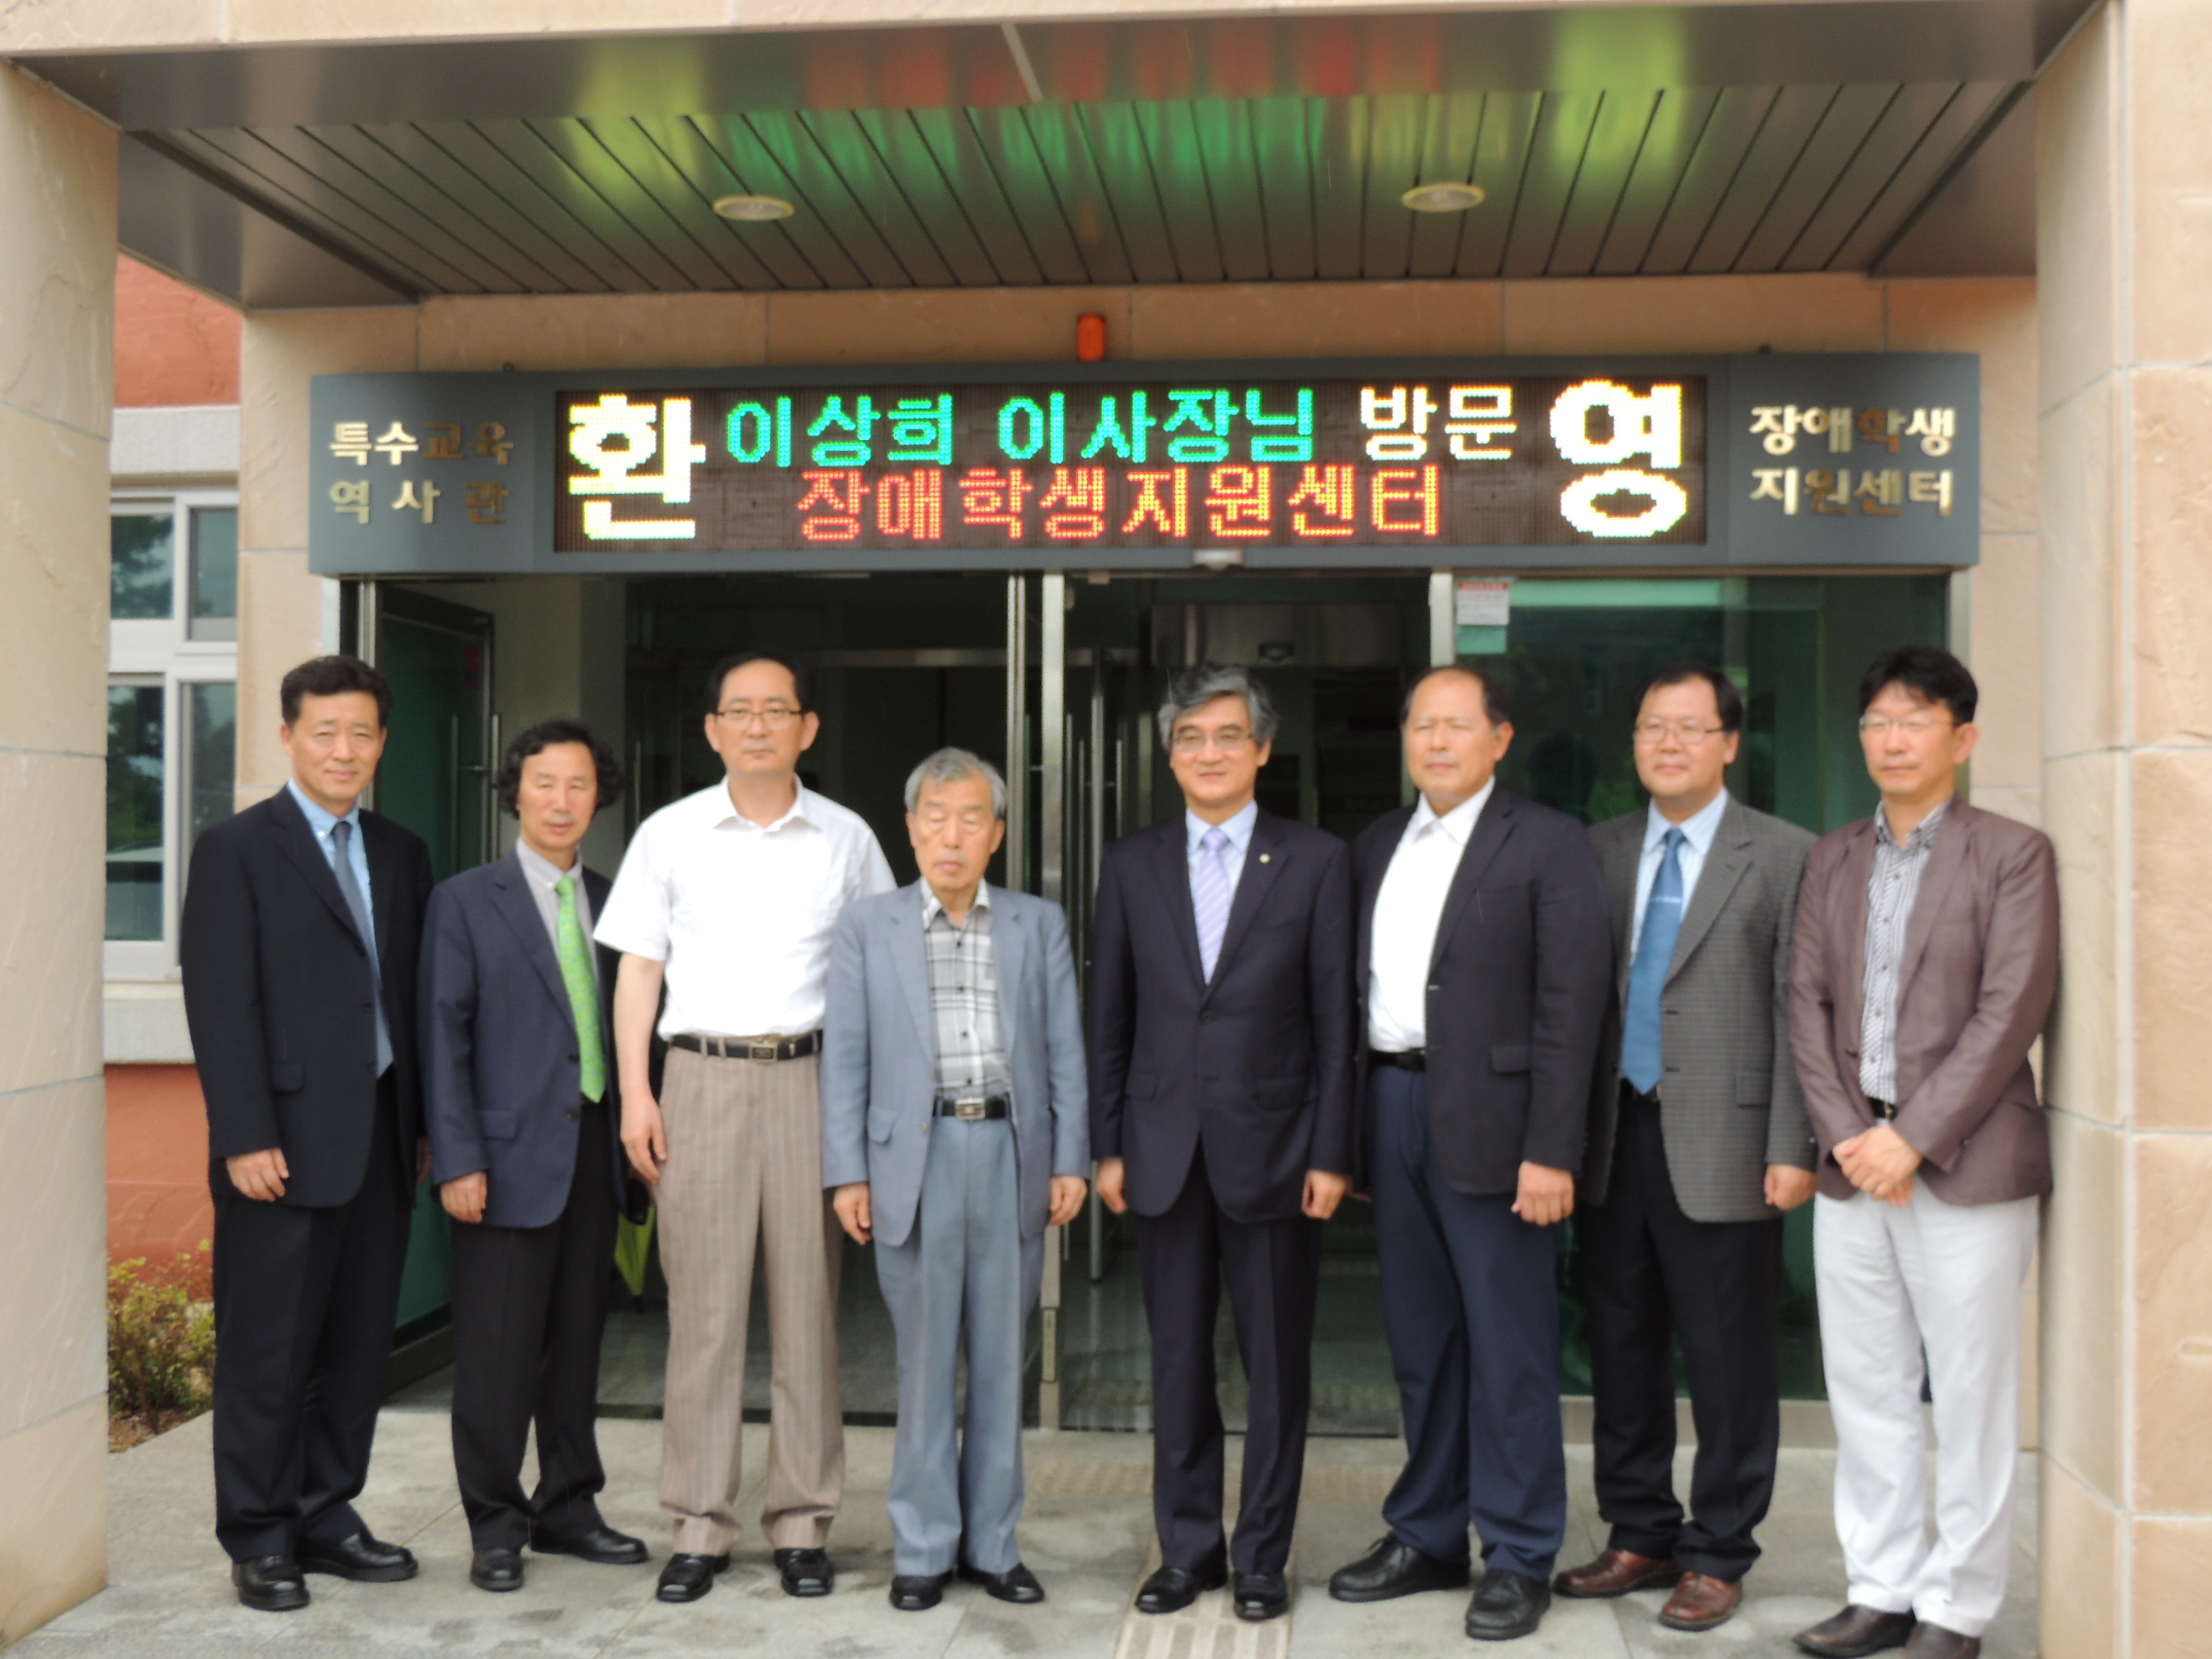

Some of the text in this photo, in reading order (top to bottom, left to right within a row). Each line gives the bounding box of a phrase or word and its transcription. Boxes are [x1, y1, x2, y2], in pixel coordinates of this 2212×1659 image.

[330, 421, 512, 466] 특수교육
[726, 386, 1517, 467] 이상희 이사장님 방문
[1750, 404, 1956, 457] 장애학생
[1750, 466, 1953, 517] 지원센터
